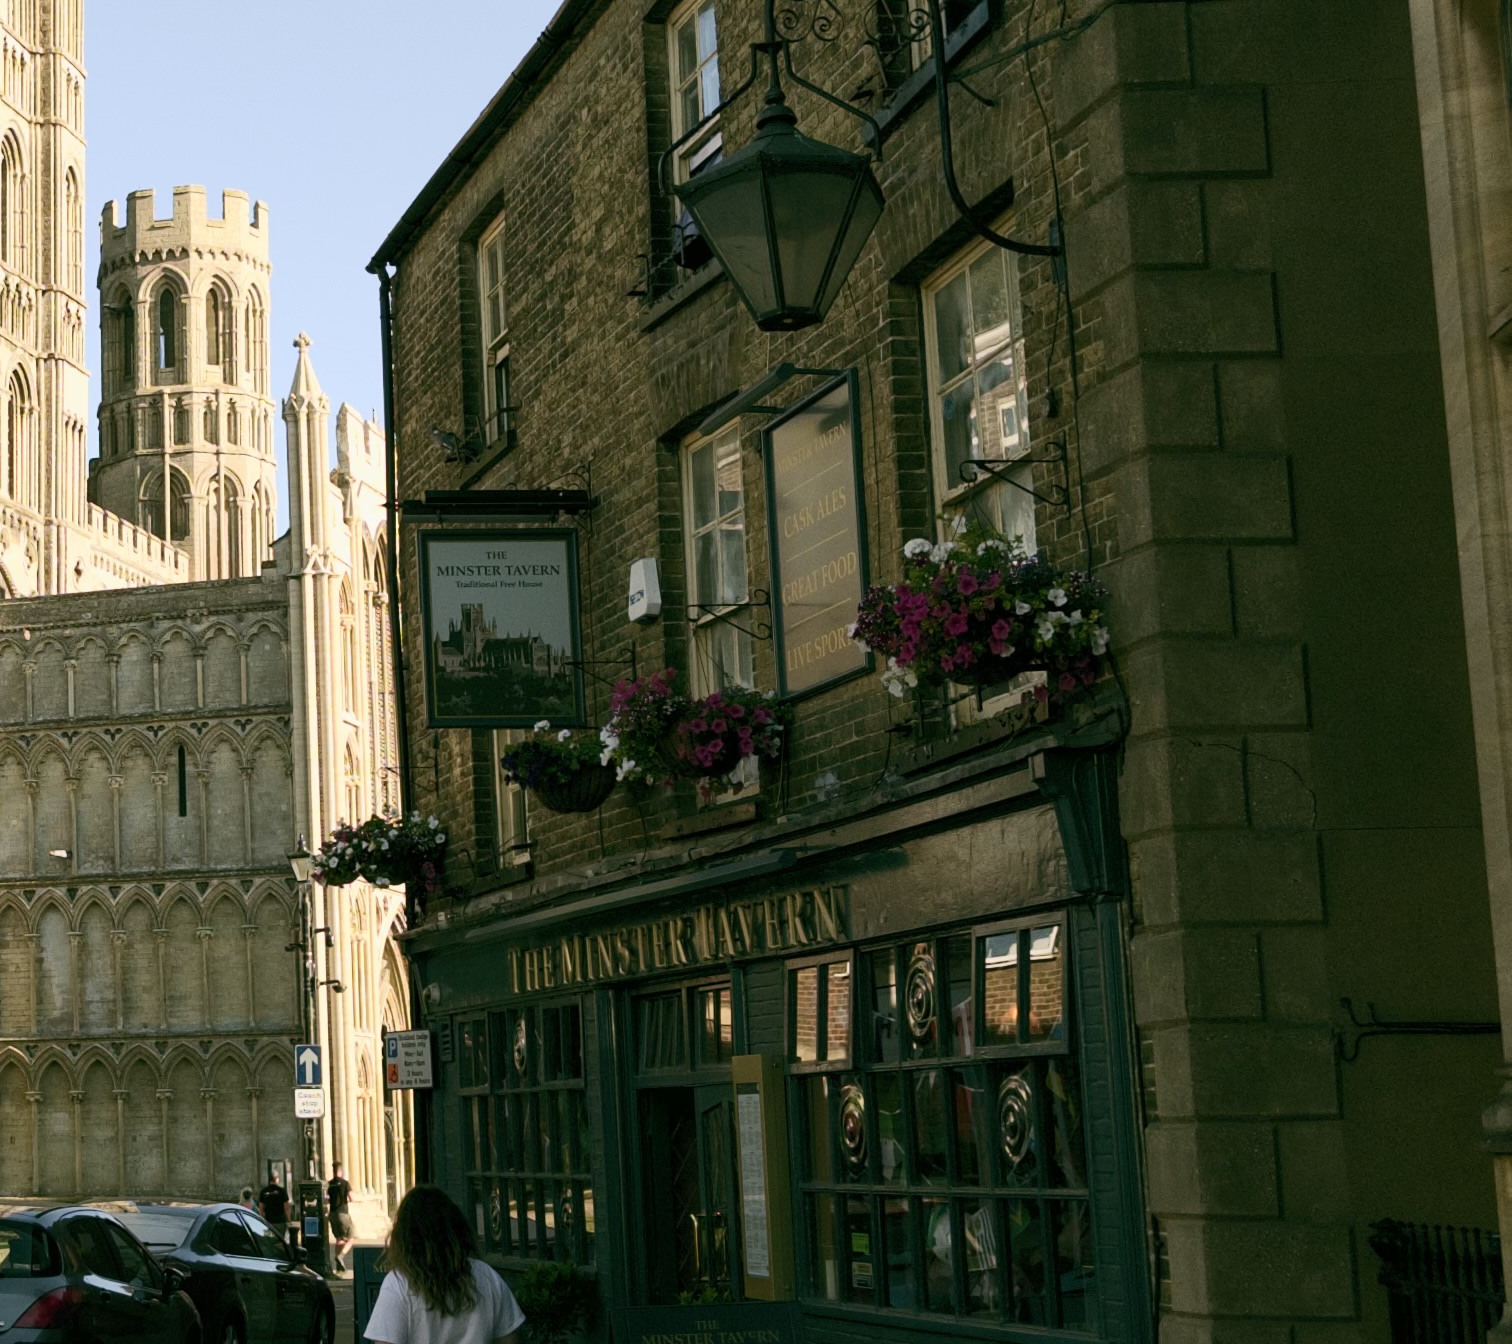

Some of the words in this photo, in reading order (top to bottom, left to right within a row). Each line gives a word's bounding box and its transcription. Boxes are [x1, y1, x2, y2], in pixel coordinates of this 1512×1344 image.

[485, 550, 507, 560] THE
[437, 565, 501, 576] MINSTER
[505, 564, 560, 575] TAVERN
[455, 580, 498, 588] Traditional
[518, 580, 543, 588] House
[508, 947, 554, 993] THE
[560, 916, 688, 984] MINSTER
[694, 886, 844, 959] TAVERN
[695, 1320, 719, 1330] THE
